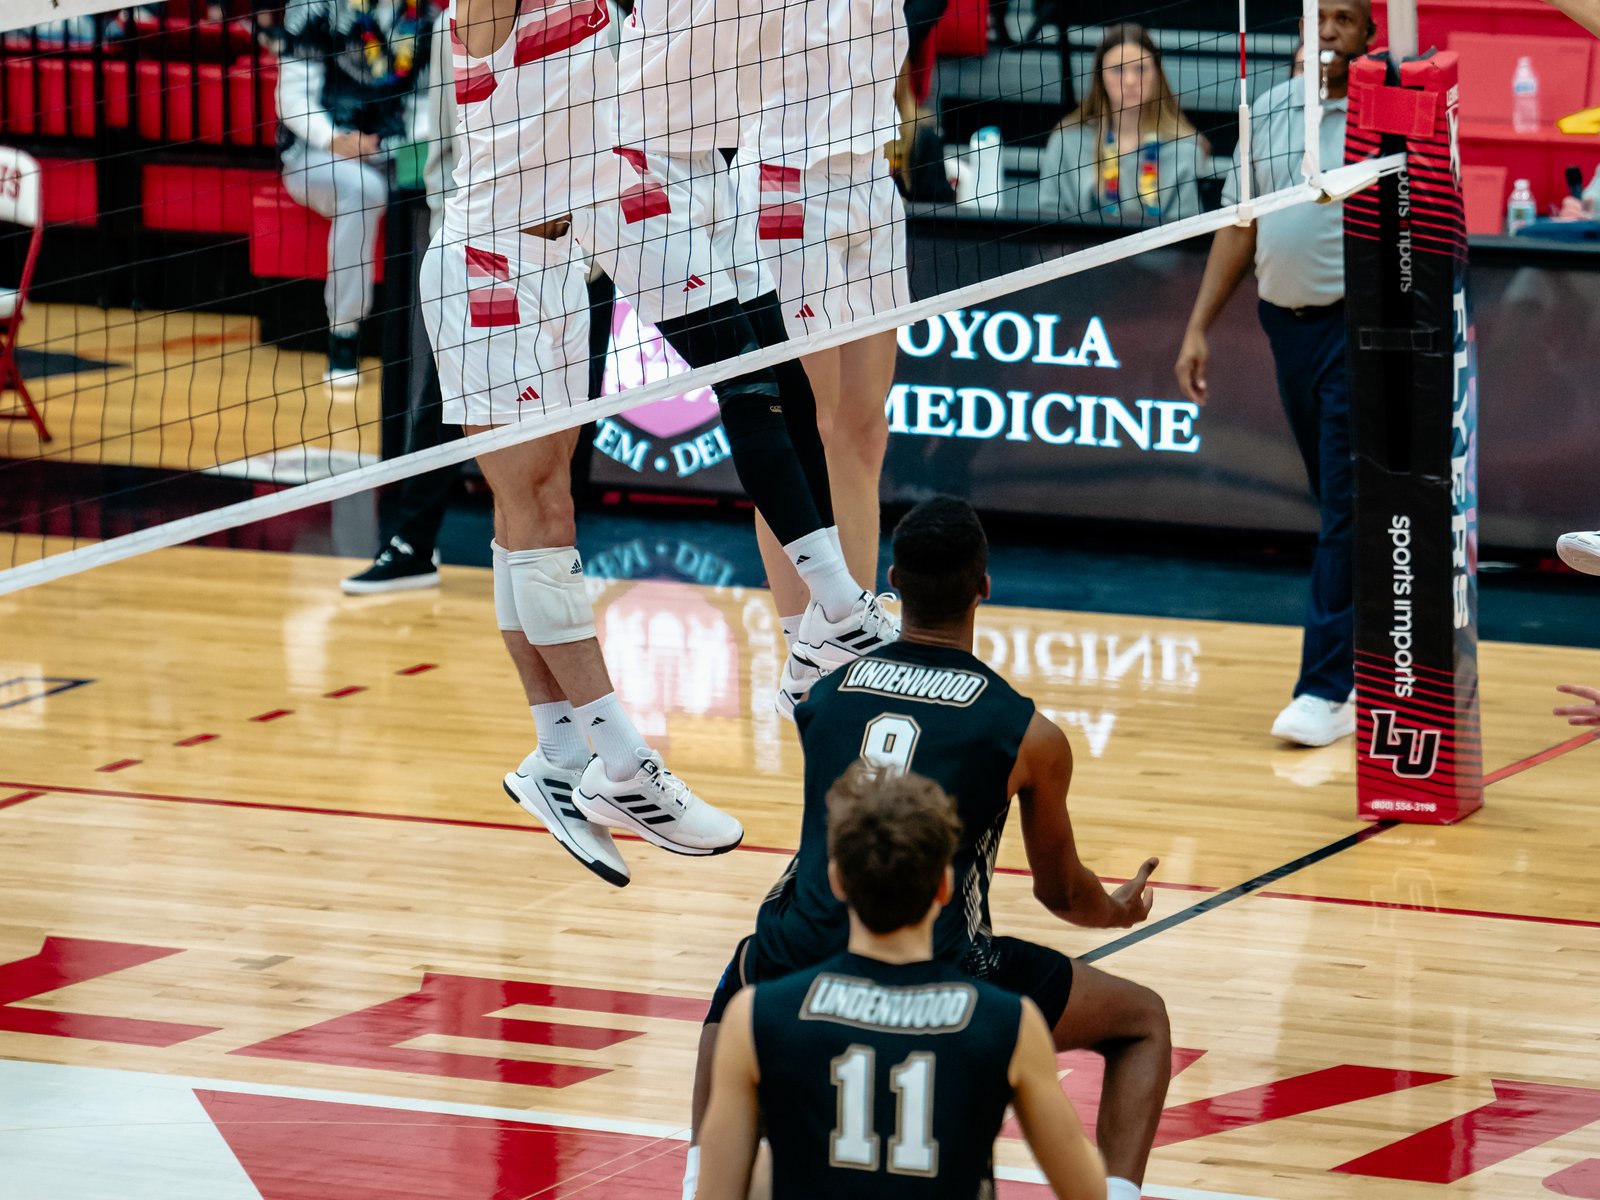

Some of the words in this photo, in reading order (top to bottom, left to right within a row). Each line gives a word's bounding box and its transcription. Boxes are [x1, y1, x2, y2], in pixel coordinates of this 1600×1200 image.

[896, 309, 1121, 369] OYOLA
[1387, 514, 1414, 595] sports
[845, 658, 984, 703] LINDENWOOD
[1389, 600, 1416, 698] imports
[1369, 709, 1442, 779] LU
[807, 976, 972, 1030] LINDENWOOD
[829, 1043, 939, 1178] 11
